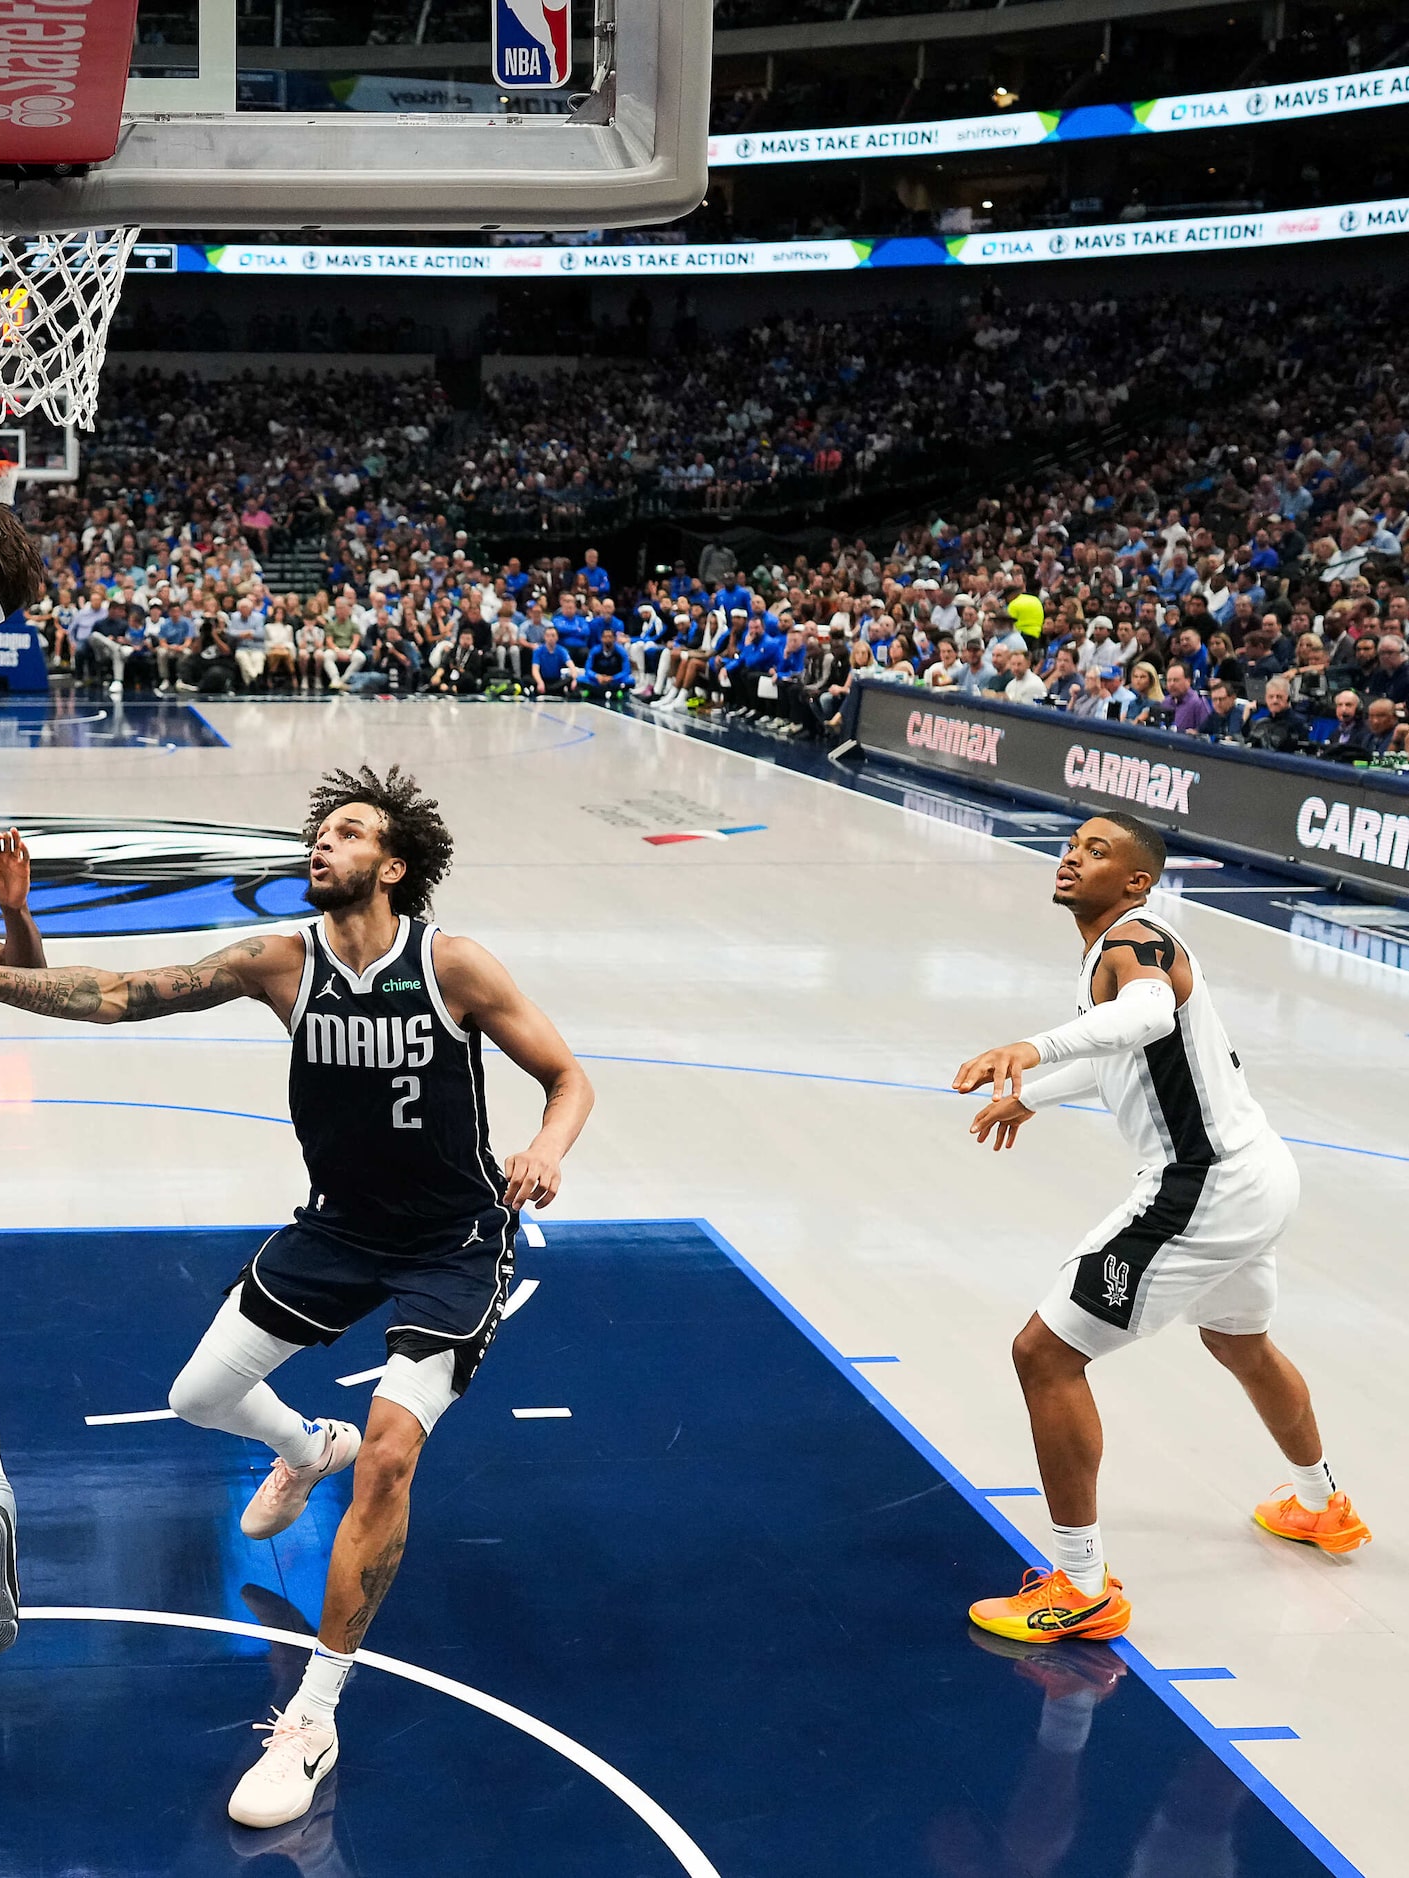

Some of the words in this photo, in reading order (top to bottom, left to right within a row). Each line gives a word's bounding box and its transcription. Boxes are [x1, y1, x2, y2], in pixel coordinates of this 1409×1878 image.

[505, 48, 541, 76] NBA
[1275, 88, 1329, 109] MAVS
[1335, 80, 1384, 101] TAKE
[1191, 103, 1229, 118] TIAA
[761, 138, 810, 154] MAVS
[817, 134, 859, 151] TAKE
[866, 129, 939, 149] ACTION!
[1367, 208, 1409, 226] MAV
[1075, 233, 1125, 249] MAVS
[1132, 229, 1178, 246] TAKE
[1185, 223, 1263, 243] ACTION!
[1000, 242, 1033, 255] TIAA
[257, 254, 287, 267] TIAA
[326, 254, 372, 268] MAVS
[378, 254, 418, 268] TAKE
[424, 255, 491, 269] ACTION!
[584, 254, 632, 268] MAVS
[637, 253, 679, 267] TAKE
[686, 252, 755, 266] ACTION!
[382, 978, 422, 993] chime
[306, 1012, 434, 1069] MAVS
[392, 1075, 422, 1128] 2
